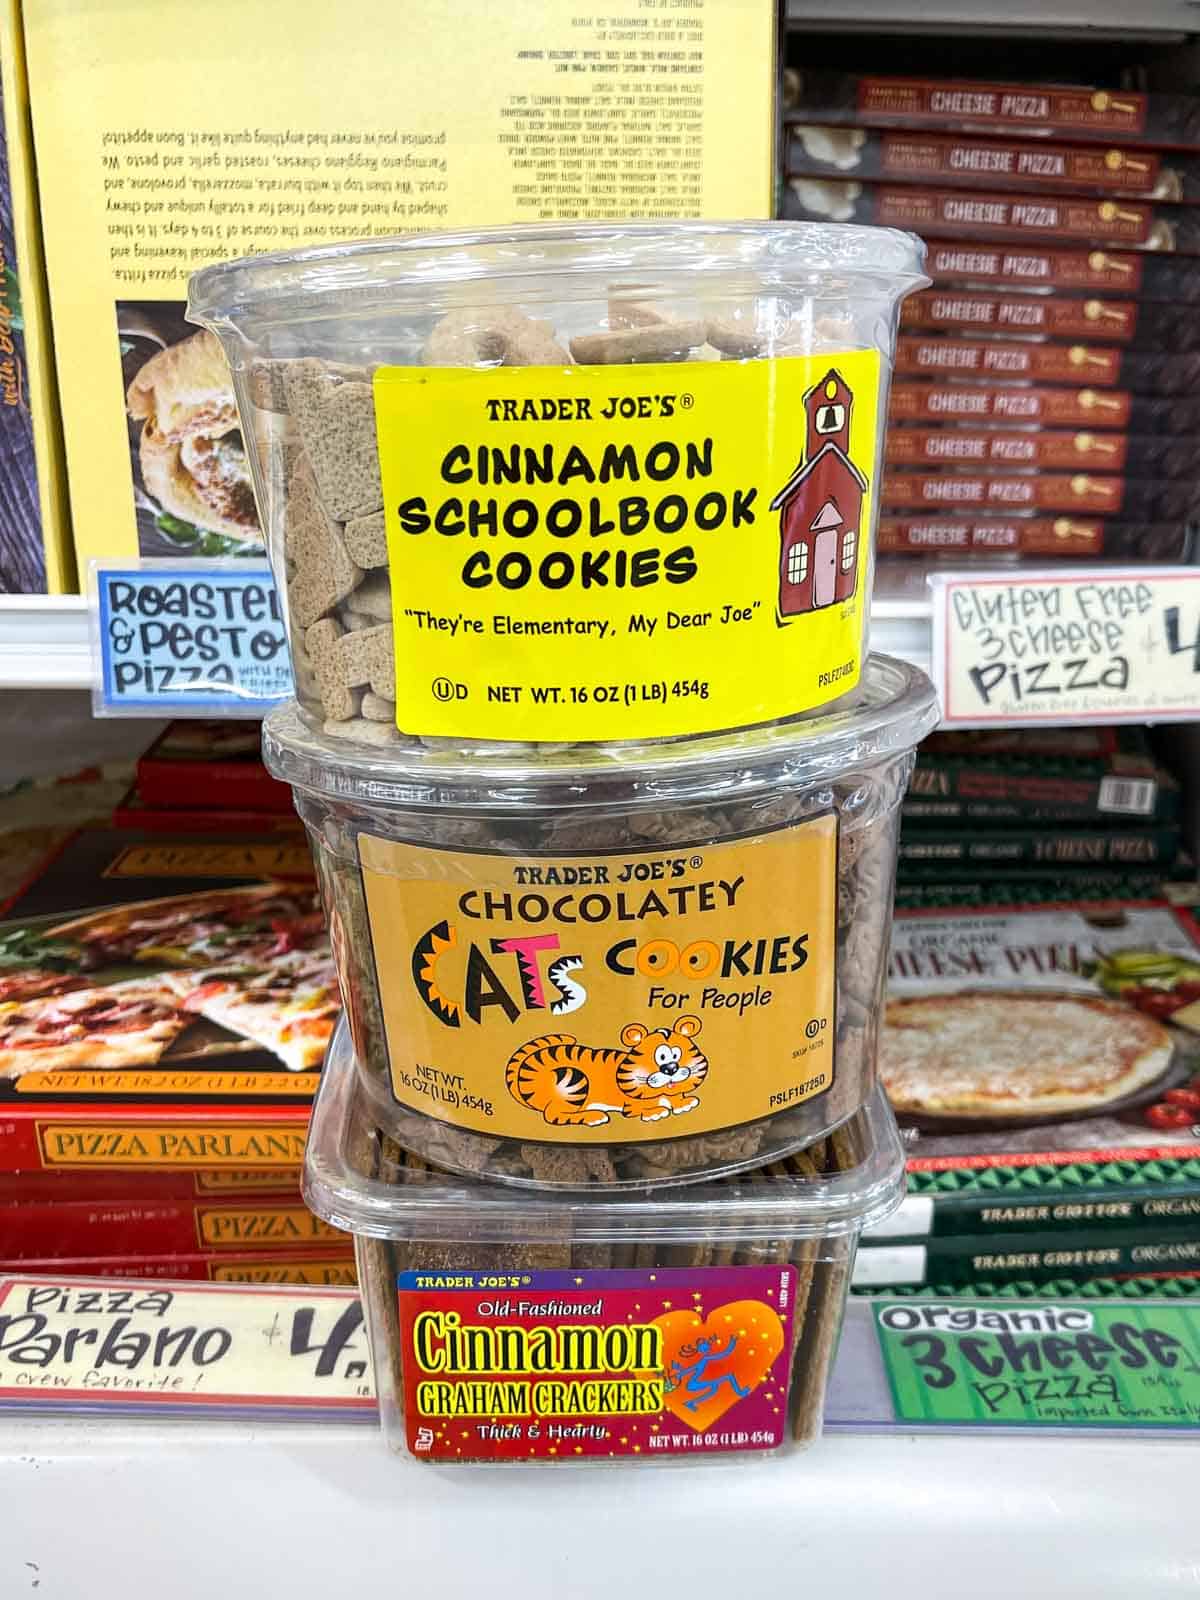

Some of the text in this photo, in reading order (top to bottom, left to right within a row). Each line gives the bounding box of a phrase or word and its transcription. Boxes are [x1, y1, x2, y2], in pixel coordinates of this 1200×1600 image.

[931, 91, 1000, 116] CHEESE
[1001, 94, 1049, 118] PIZZA
[155, 132, 184, 147] Buon
[200, 133, 220, 146] like
[223, 129, 252, 144] quite
[254, 129, 304, 147] anything
[306, 134, 328, 147] had
[330, 134, 361, 144] never
[401, 131, 445, 147] promise
[162, 156, 184, 168] and
[189, 152, 220, 169] garlic
[225, 156, 268, 169] roasted
[382, 153, 447, 172] Parmigiano
[951, 149, 1014, 174] CHEESE
[1018, 152, 1066, 176] PIZZA
[103, 179, 124, 192] and
[303, 180, 328, 192] with
[343, 178, 363, 192] top
[366, 181, 392, 194] then
[105, 198, 141, 215] chewy
[143, 202, 164, 216] and
[167, 199, 205, 214] unique
[208, 199, 245, 215] totally
[257, 203, 274, 216] for
[277, 202, 305, 216] fried
[308, 201, 335, 215] deep
[337, 203, 359, 215] and
[360, 204, 389, 216] hand
[407, 201, 448, 216] shaped
[945, 201, 1008, 224] CHEESE
[1012, 204, 1059, 228] PIZZA
[107, 225, 133, 238] then
[241, 225, 278, 236] course
[280, 226, 298, 238] the
[302, 226, 326, 236] over
[328, 224, 372, 236] process
[109, 247, 130, 259] and
[133, 243, 187, 260] leavening
[190, 245, 229, 260] special
[936, 252, 1050, 277] CHEESE PIZZA
[932, 301, 1044, 325] CHEESE PIZZA
[486, 397, 593, 422] TRADER
[440, 438, 714, 485] CINNAMON
[398, 488, 758, 537] SCHOOLBOOK
[461, 548, 698, 590] COOKIES
[953, 583, 1153, 631] Gluten Free
[493, 615, 617, 638] Elementary,
[628, 614, 658, 636] My
[666, 611, 712, 630] Dear
[968, 656, 1129, 705] Pizza
[487, 680, 709, 707] NET WT. 16 OZ (1 LB) 454g
[514, 865, 610, 887] TRADER
[458, 876, 745, 923] CHOCOLATEY
[605, 933, 810, 980] COOKIES
[648, 984, 773, 1016] For People
[416, 1063, 468, 1091] NET WT.
[400, 1070, 411, 1087] 16
[412, 1078, 430, 1095] OZ
[442, 1087, 460, 1108] LB)
[462, 1095, 494, 1117] 454g
[56, 1133, 148, 1157] PIZZA
[981, 1206, 1048, 1222] TRADER
[213, 1215, 302, 1238] PIZZA
[973, 1253, 1040, 1270] TRADER
[416, 1277, 474, 1288] TRADER
[26, 1287, 174, 1317] Pizza
[477, 1300, 603, 1318] Old-Fashioned
[0, 1314, 233, 1370] Parlano
[414, 1312, 664, 1374] Cinnamon
[902, 1334, 956, 1389] 3
[15, 1371, 72, 1387] crew
[417, 1379, 664, 1417] GRAHAM CRACKERS
[1038, 1404, 1110, 1421] imported
[478, 1425, 523, 1440] Thick
[528, 1425, 540, 1438] &
[649, 1435, 671, 1448] NET
[671, 1434, 691, 1448] WT.
[692, 1434, 702, 1446] 16
[704, 1433, 719, 1446] OZ
[750, 1431, 775, 1446] 454g
